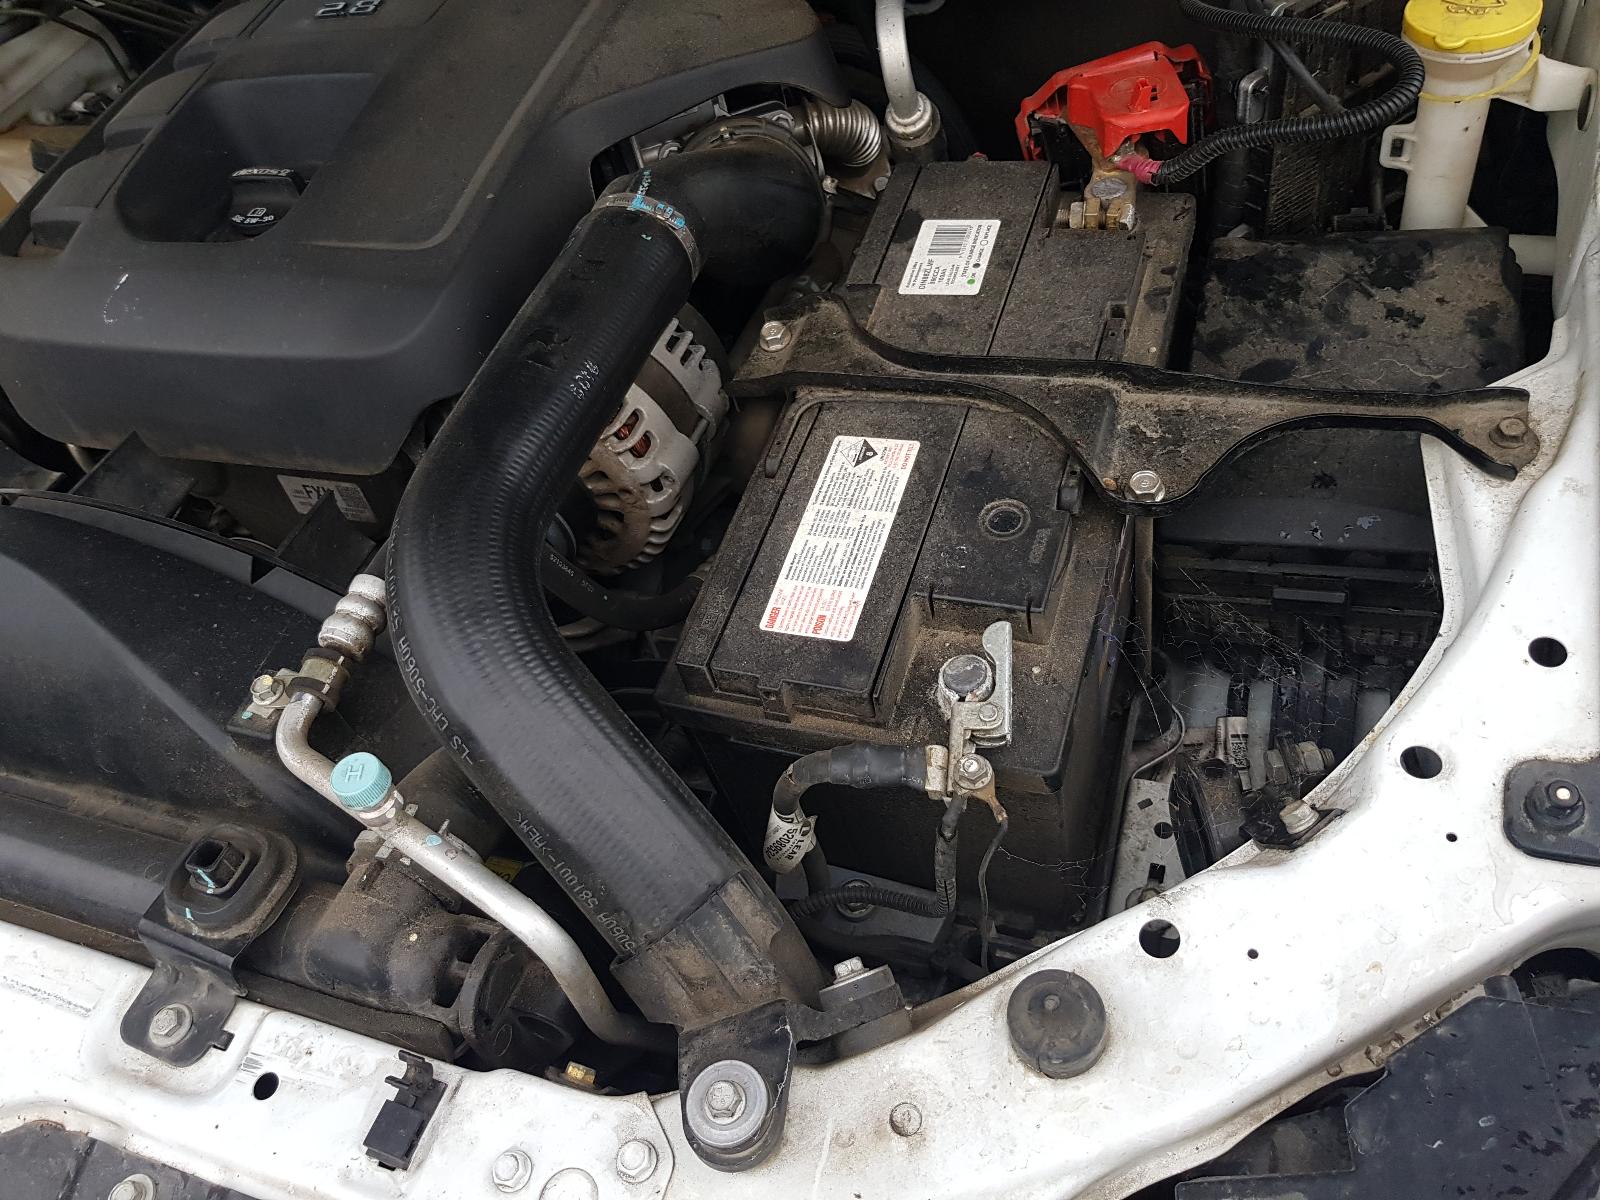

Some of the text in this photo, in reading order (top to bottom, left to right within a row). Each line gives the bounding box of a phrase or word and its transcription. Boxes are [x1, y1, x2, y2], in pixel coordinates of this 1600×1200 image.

[315, 0, 381, 17] 2.8
[764, 606, 781, 628] DANGER
[810, 613, 827, 634] POISON
[345, 763, 364, 783] H
[785, 839, 804, 860] LEAR
